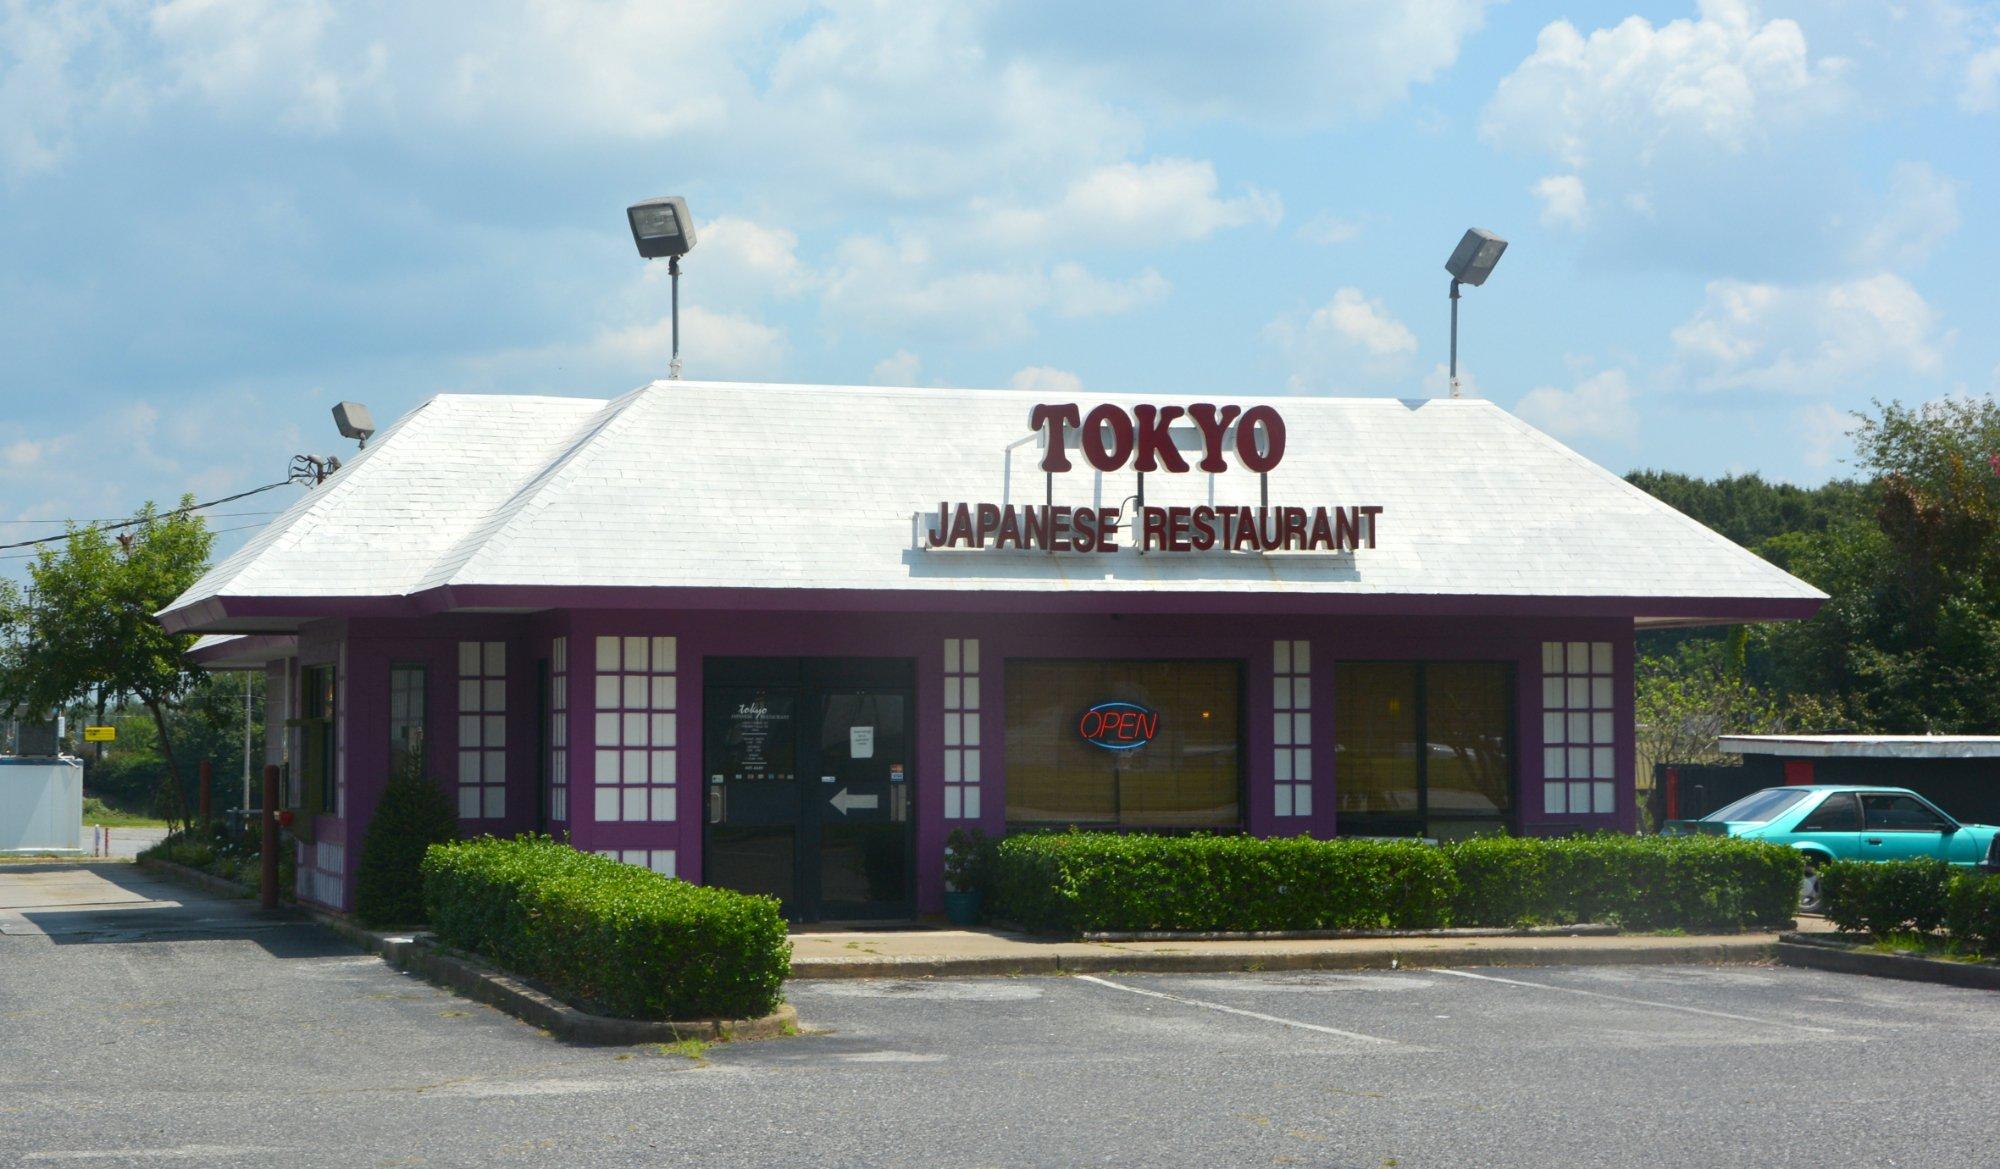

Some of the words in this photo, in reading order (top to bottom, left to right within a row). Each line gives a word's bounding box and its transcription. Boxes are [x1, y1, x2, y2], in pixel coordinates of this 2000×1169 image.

[1029, 403, 1286, 473] TOKYO
[928, 502, 1120, 552] JAPANESE
[1142, 505, 1384, 552] RESTAURANT
[1079, 709, 1159, 740] OPEN
